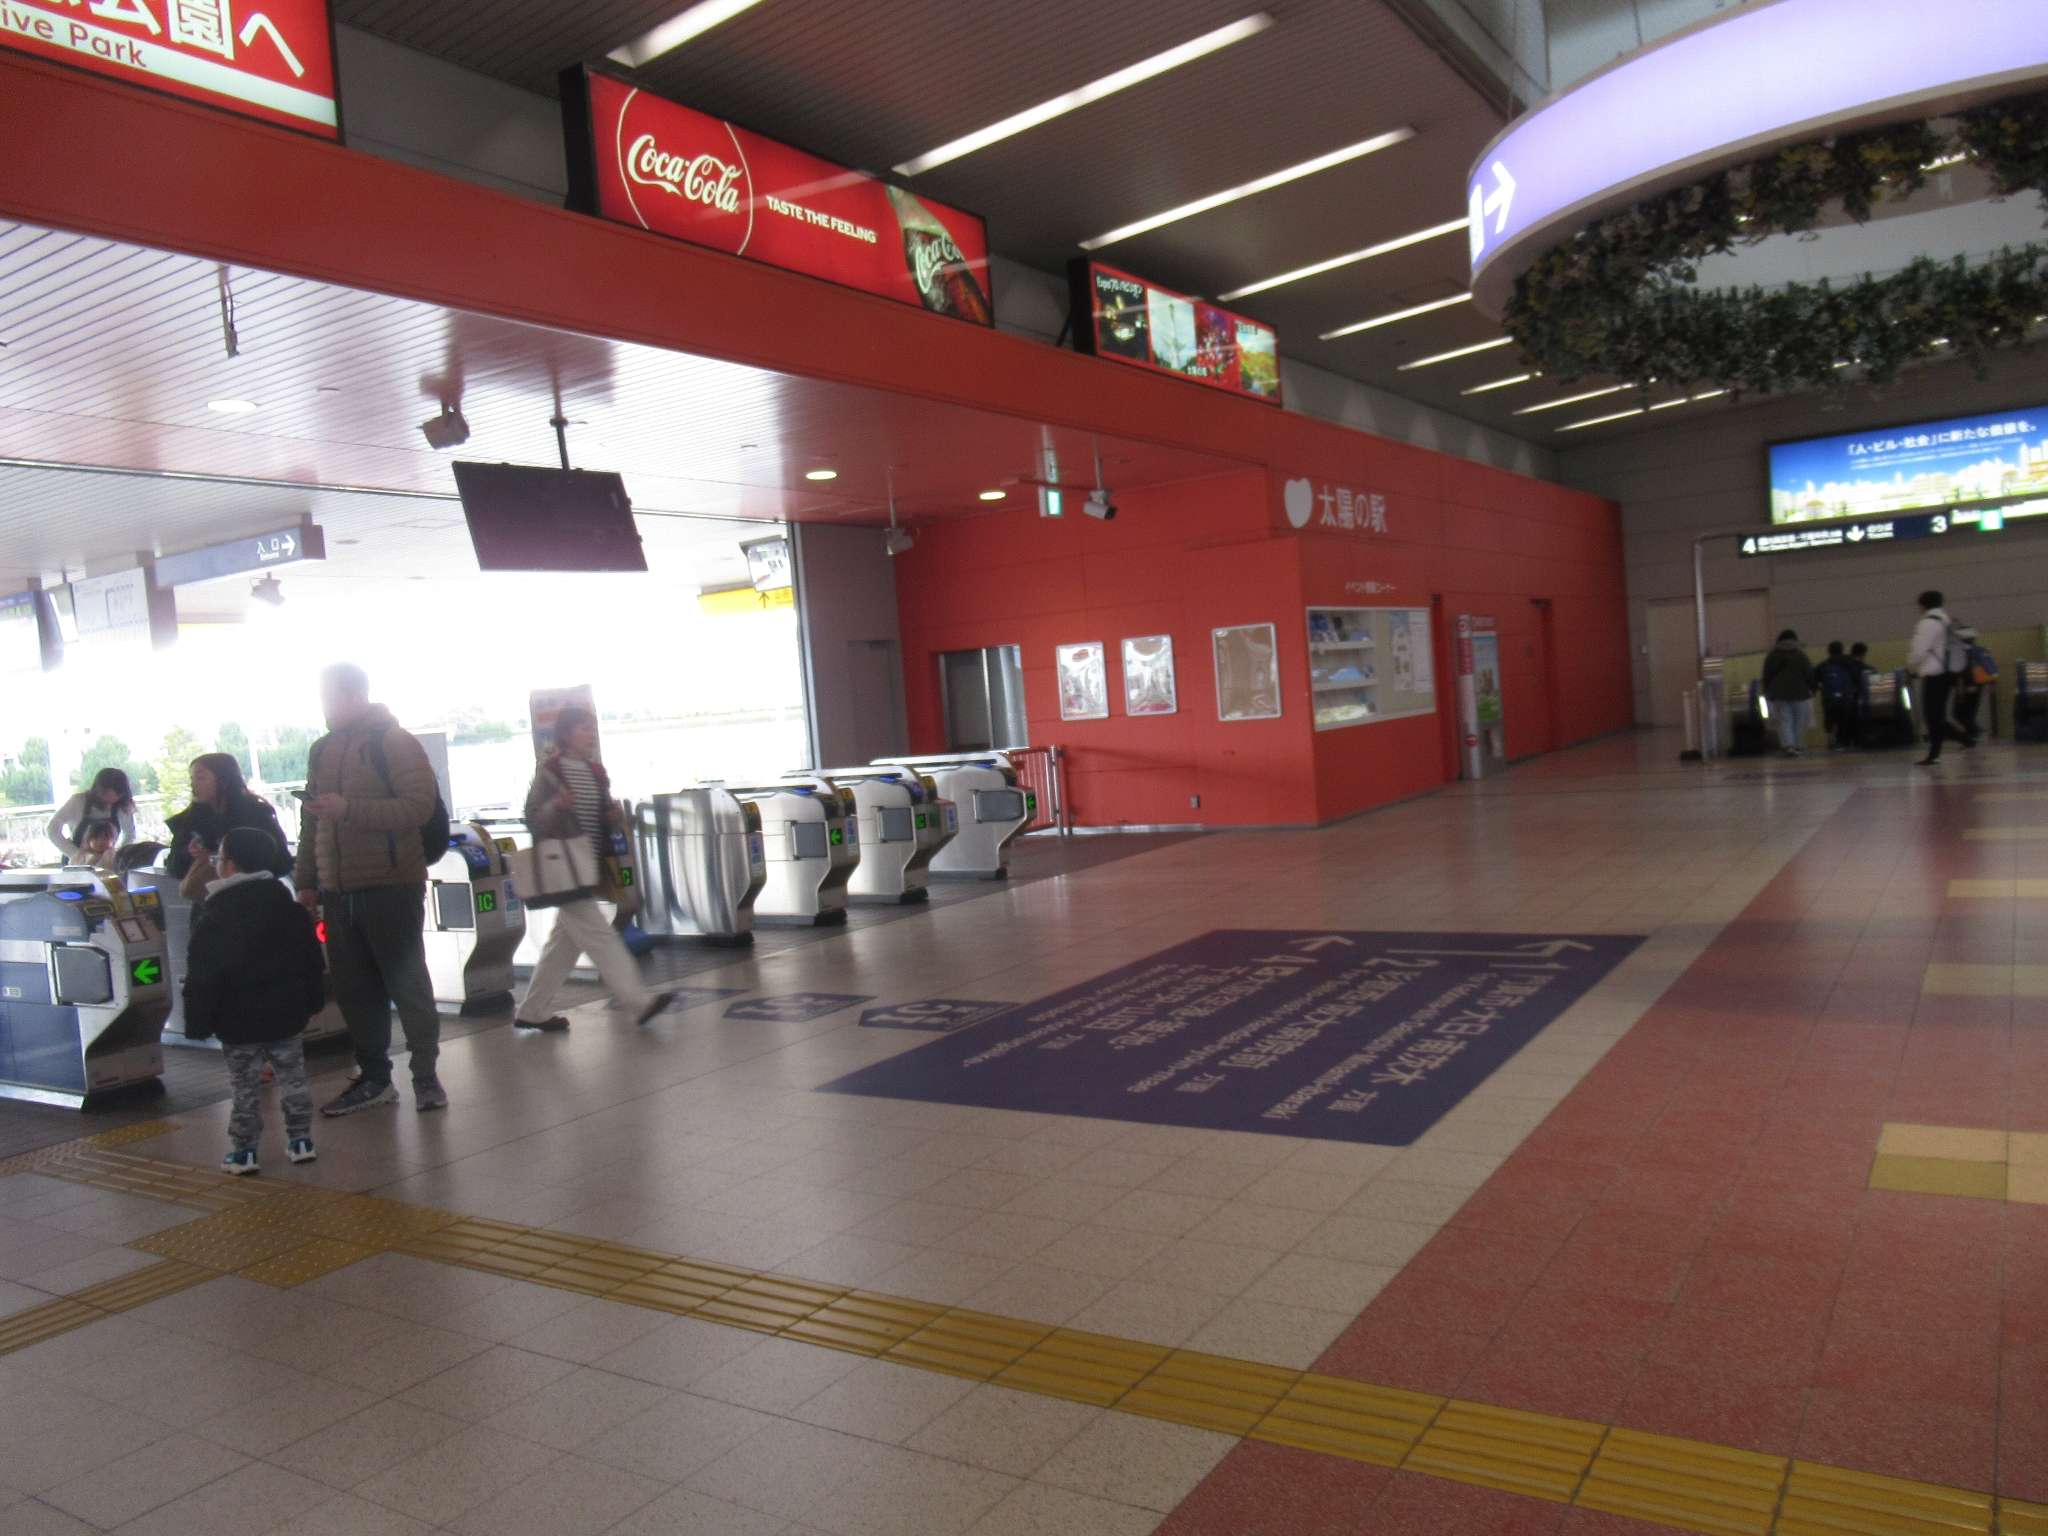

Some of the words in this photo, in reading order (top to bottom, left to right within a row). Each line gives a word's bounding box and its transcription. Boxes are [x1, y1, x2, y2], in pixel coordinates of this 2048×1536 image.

[69, 22, 146, 67] Park
[627, 134, 743, 212] Coca-Cola
[766, 195, 804, 221] TASTE
[804, 208, 831, 229] THE
[829, 218, 878, 244] FEELING
[1931, 515, 1947, 533] 3
[1742, 537, 1756, 554] 4
[477, 894, 493, 911] IC
